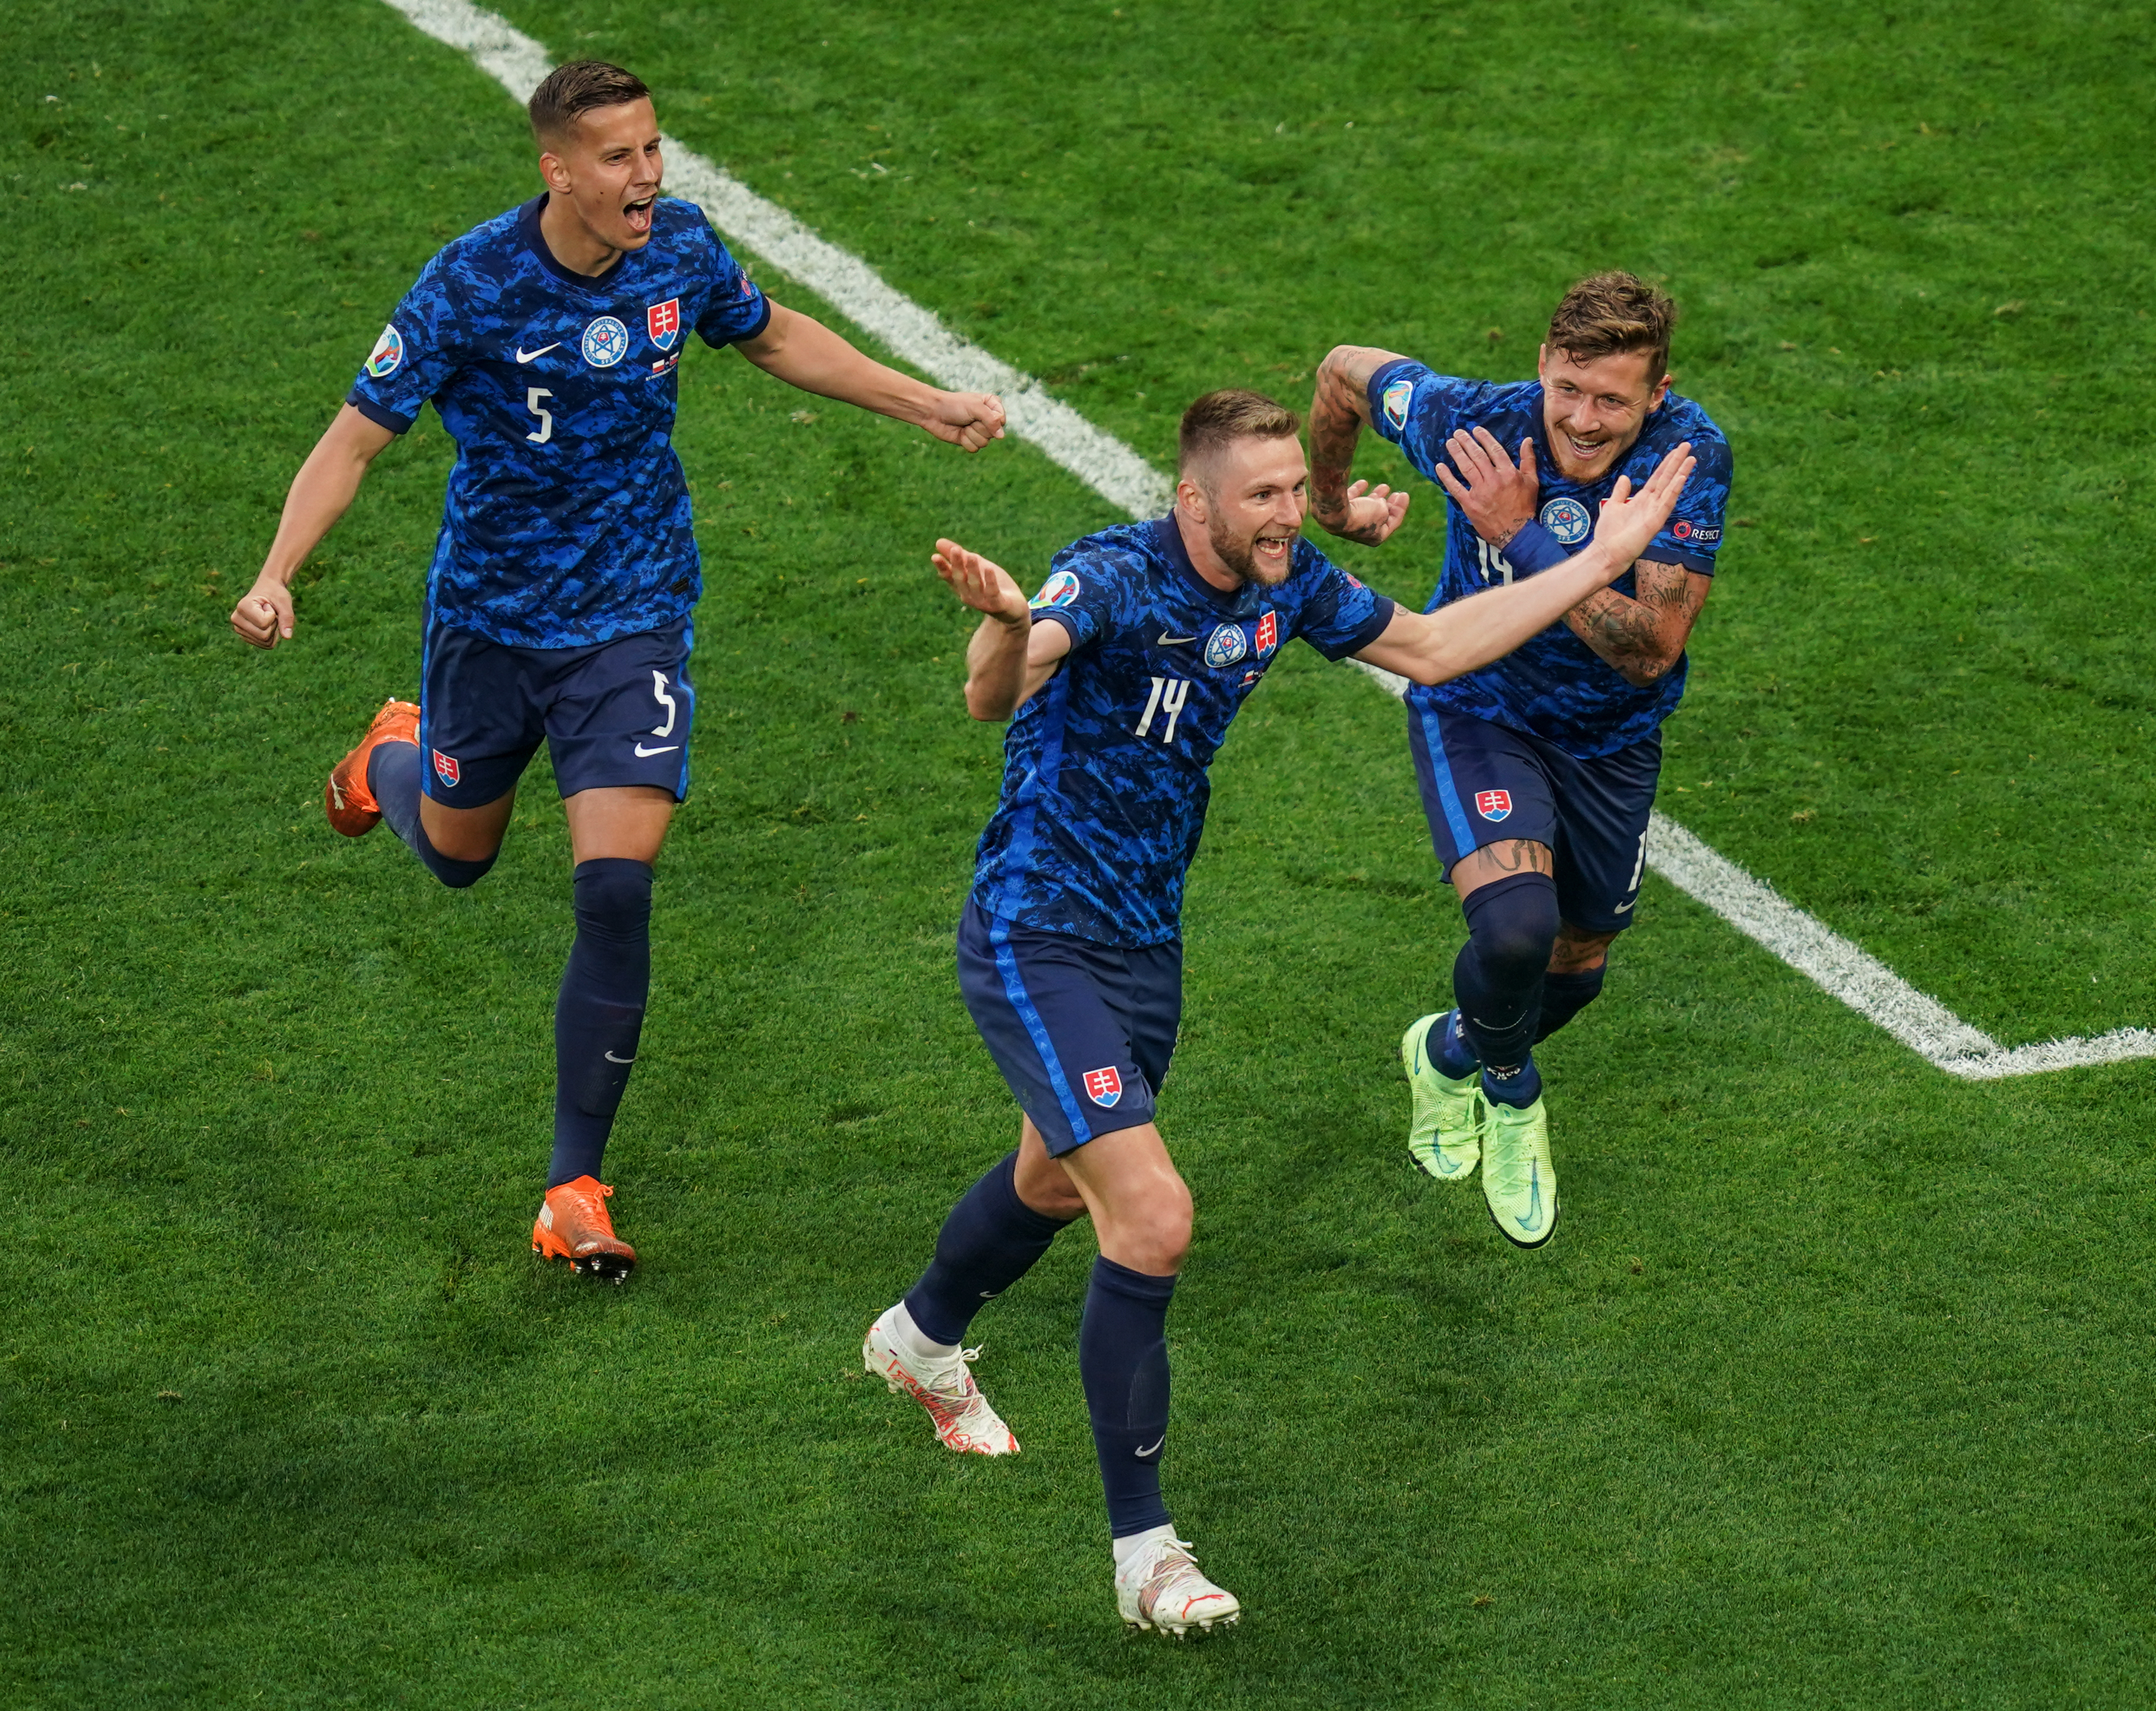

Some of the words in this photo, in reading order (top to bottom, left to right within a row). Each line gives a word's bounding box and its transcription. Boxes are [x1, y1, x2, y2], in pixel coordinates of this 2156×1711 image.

[526, 387, 553, 444] 5
[651, 670, 675, 738] 5
[1135, 677, 1191, 743] 14
[1627, 830, 1646, 892] 1
